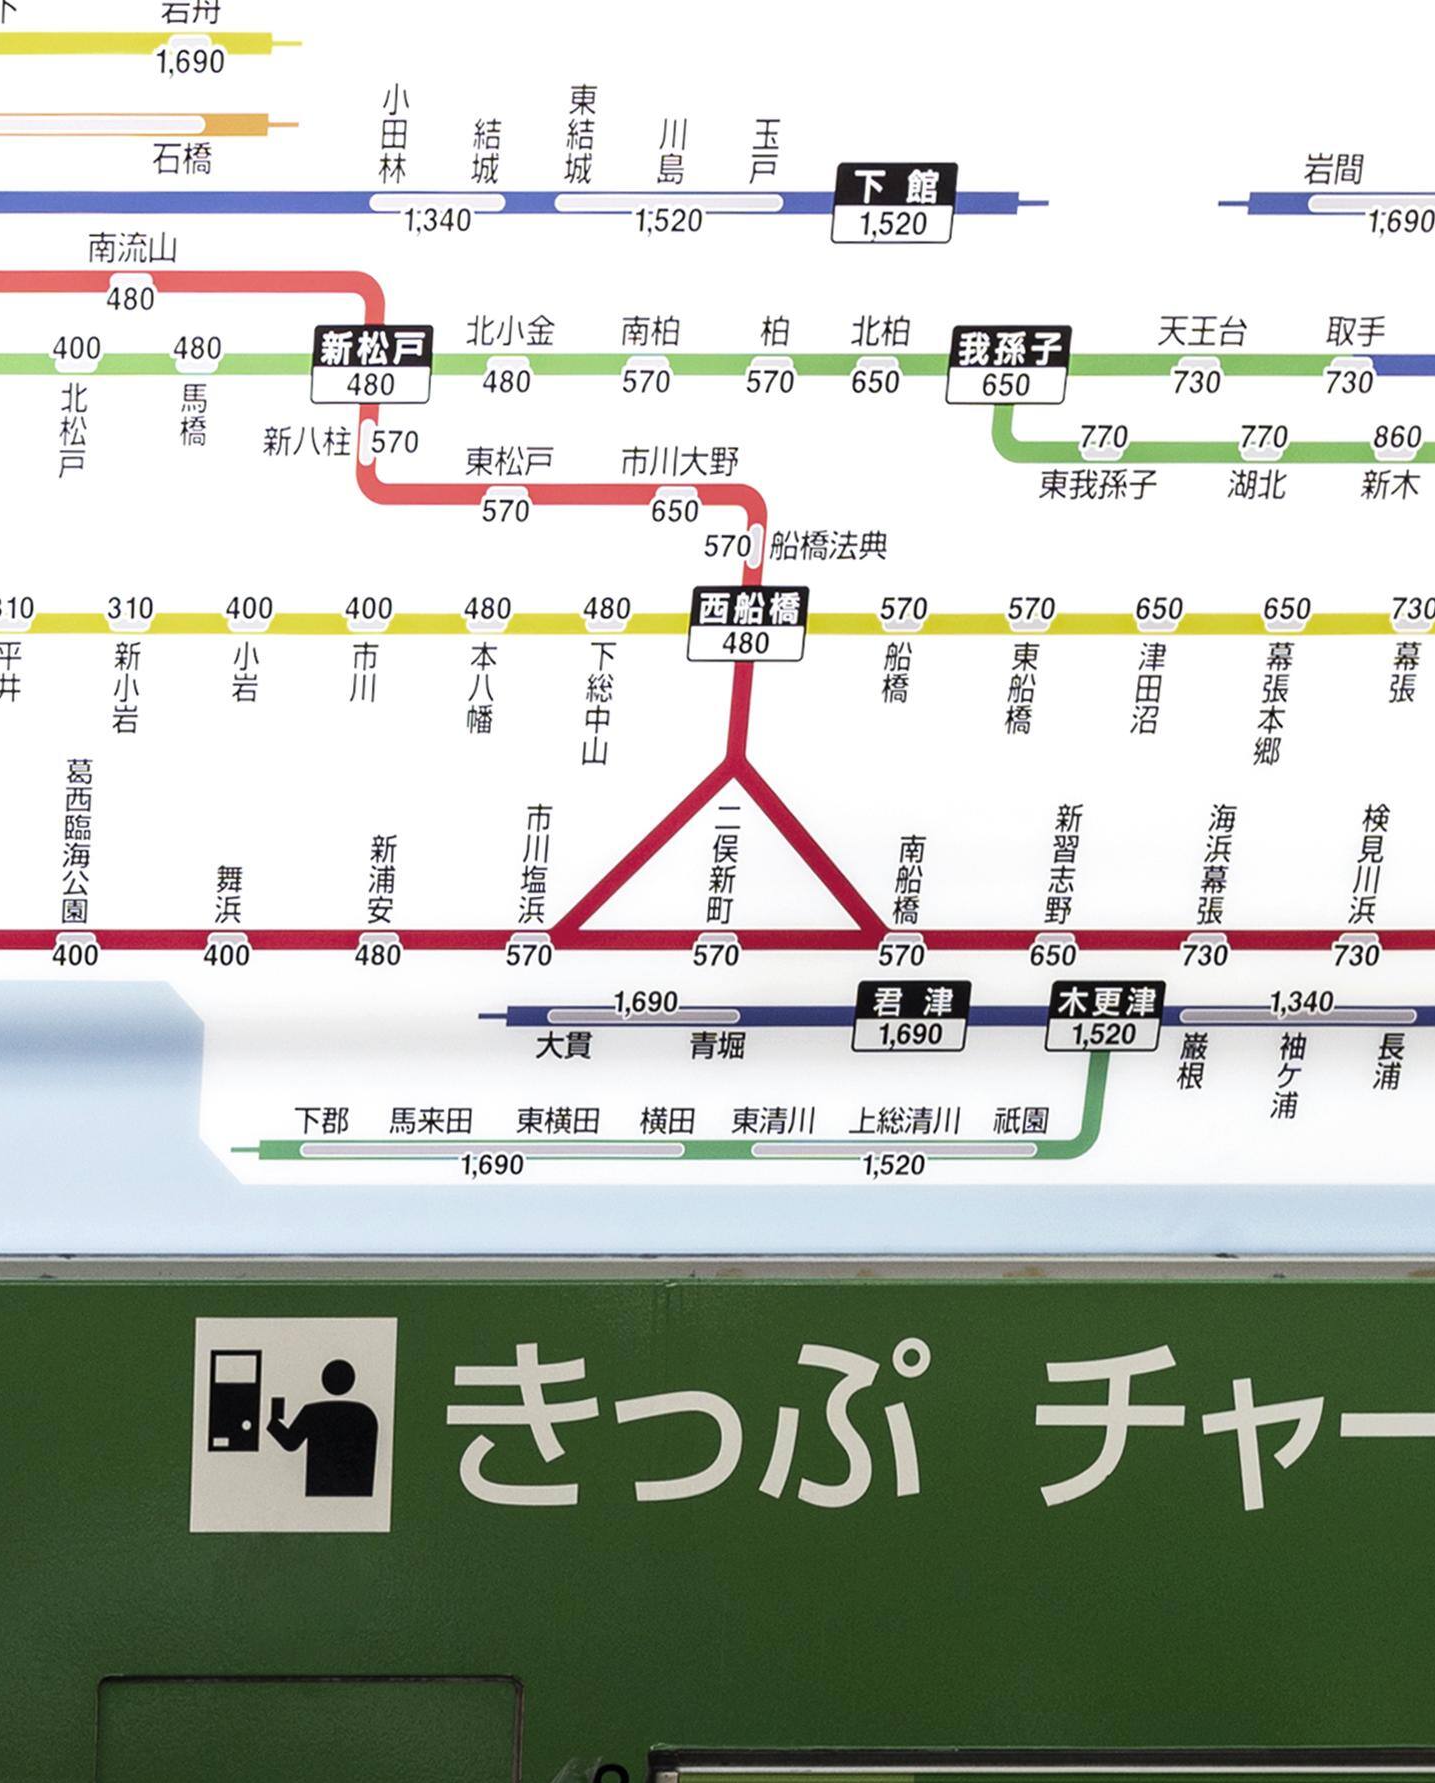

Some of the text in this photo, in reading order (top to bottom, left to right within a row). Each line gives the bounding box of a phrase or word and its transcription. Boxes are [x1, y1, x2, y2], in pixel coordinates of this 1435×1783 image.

[157, 49, 224, 74] 1,690
[564, 84, 598, 185] 東結城
[860, 211, 927, 237] 1,520
[466, 314, 555, 346] 北小金
[320, 330, 426, 366] 新松戸
[958, 330, 1063, 366] 我孫子
[263, 426, 351, 456] 新八柱
[622, 445, 739, 477] 市川大野
[699, 592, 801, 625] 西船橋
[1253, 641, 1295, 766] 幕張本郷
[61, 758, 93, 924] 葛西臨海公園
[518, 803, 553, 924] 市川塩浜
[1057, 987, 1157, 1017] 木更津
[848, 1106, 961, 1135] 上総清川
[446, 1337, 931, 1508] きっぷ
